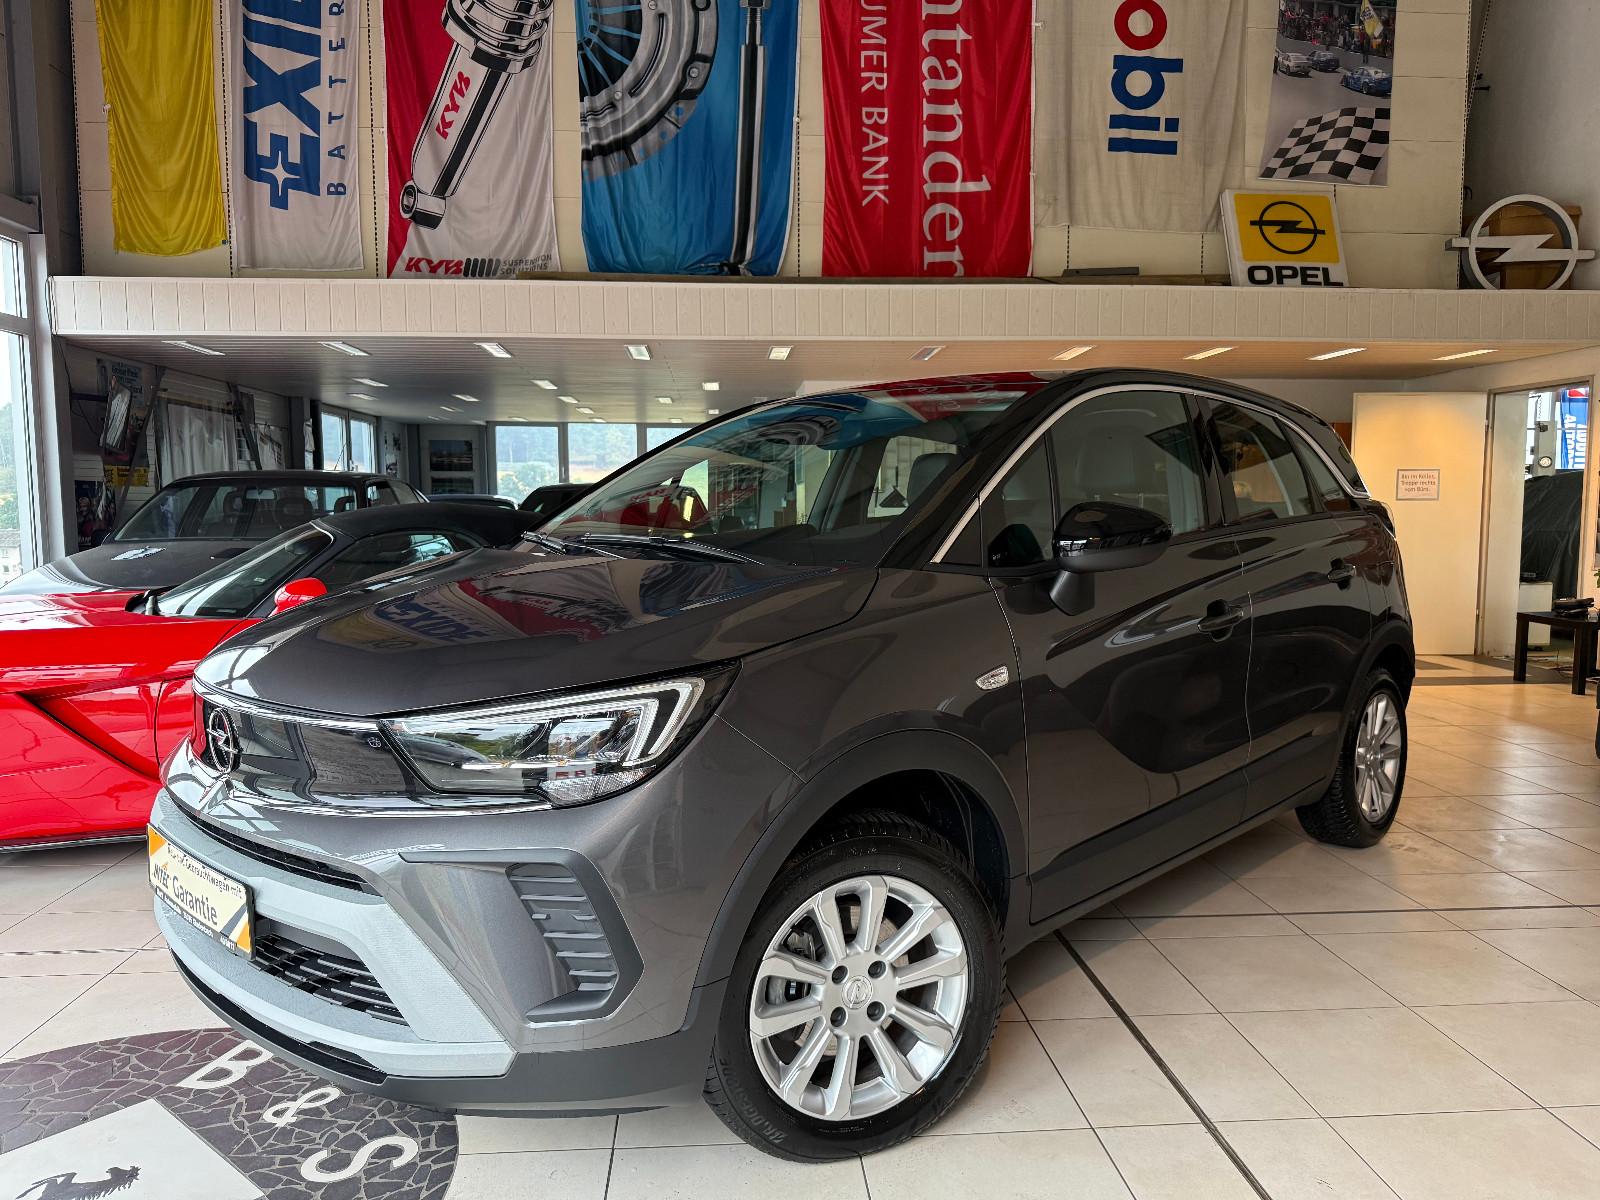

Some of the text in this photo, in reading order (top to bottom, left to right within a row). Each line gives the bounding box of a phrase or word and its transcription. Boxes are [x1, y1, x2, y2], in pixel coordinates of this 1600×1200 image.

[434, 71, 471, 140] KYB
[1108, 0, 1184, 155] obil
[860, 107, 889, 206] BANK
[405, 257, 463, 275] KYB
[1247, 265, 1344, 287] OPEL
[172, 875, 218, 926] Garantie
[176, 1040, 420, 1184] B & S
